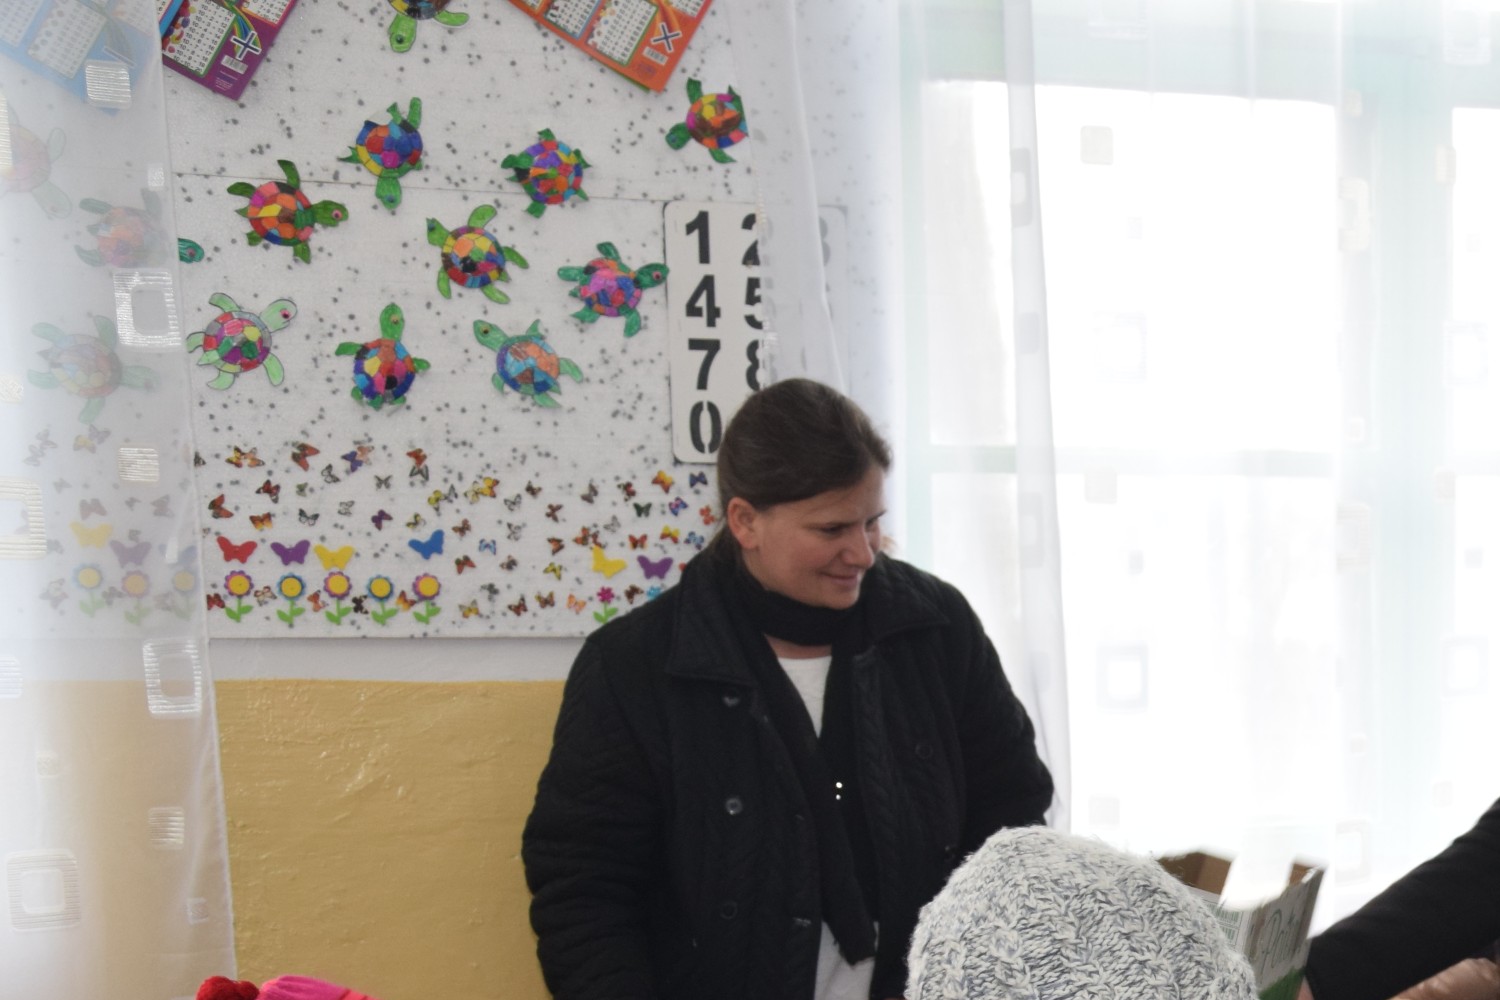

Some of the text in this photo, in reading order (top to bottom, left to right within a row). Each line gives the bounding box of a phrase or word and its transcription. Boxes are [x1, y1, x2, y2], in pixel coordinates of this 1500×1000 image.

[685, 210, 710, 264] 1
[741, 213, 768, 267] 2
[685, 274, 768, 330] 4 5
[688, 338, 721, 391] 7
